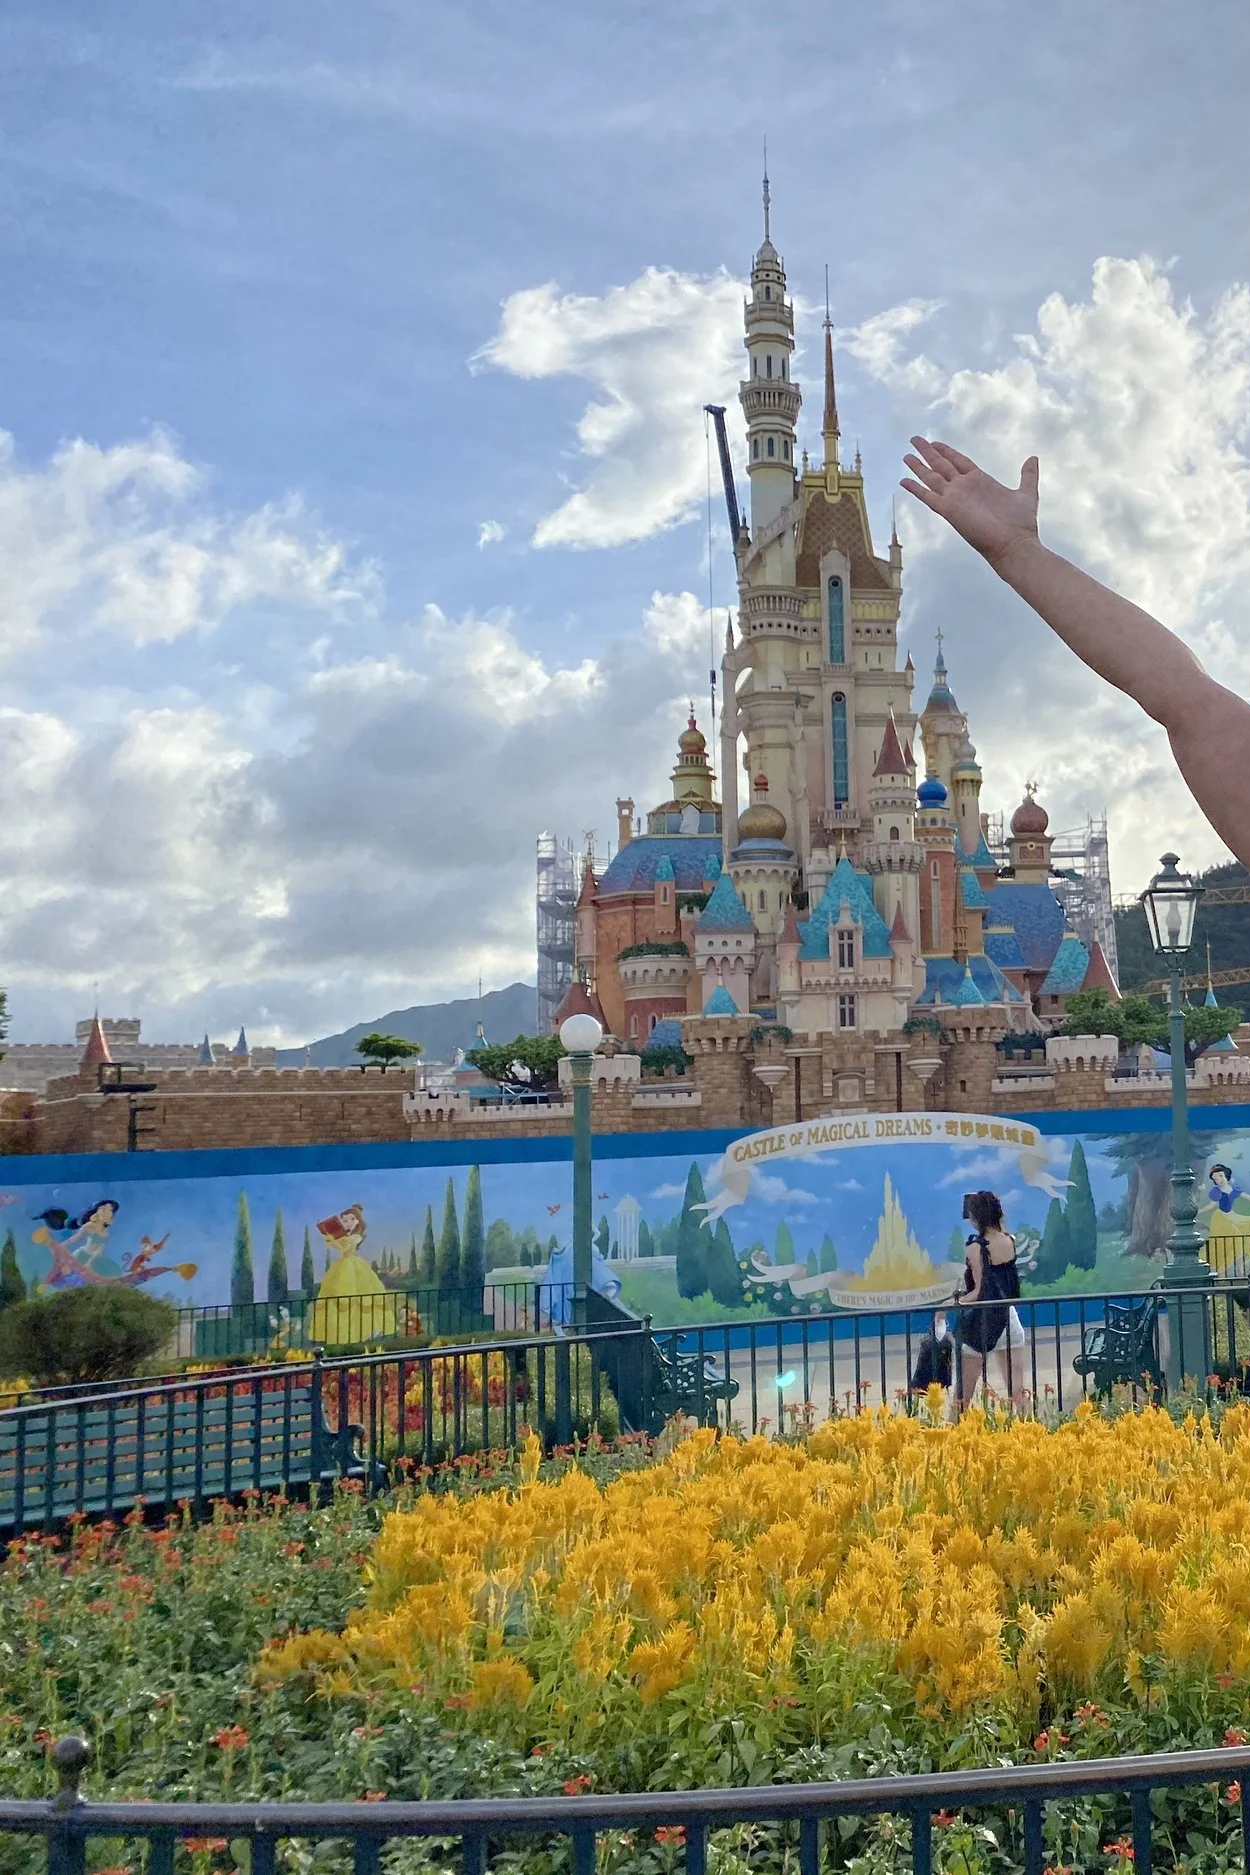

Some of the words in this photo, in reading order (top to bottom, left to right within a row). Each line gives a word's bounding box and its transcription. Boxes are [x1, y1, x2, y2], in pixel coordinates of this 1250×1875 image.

[733, 1134, 786, 1163] CASTLE
[789, 1131, 804, 1146] OF
[807, 1120, 870, 1146] MAGICAL
[874, 1118, 932, 1137] DREAMS
[869, 1295, 894, 1306] MAGIC
[905, 1294, 917, 1303] THE
